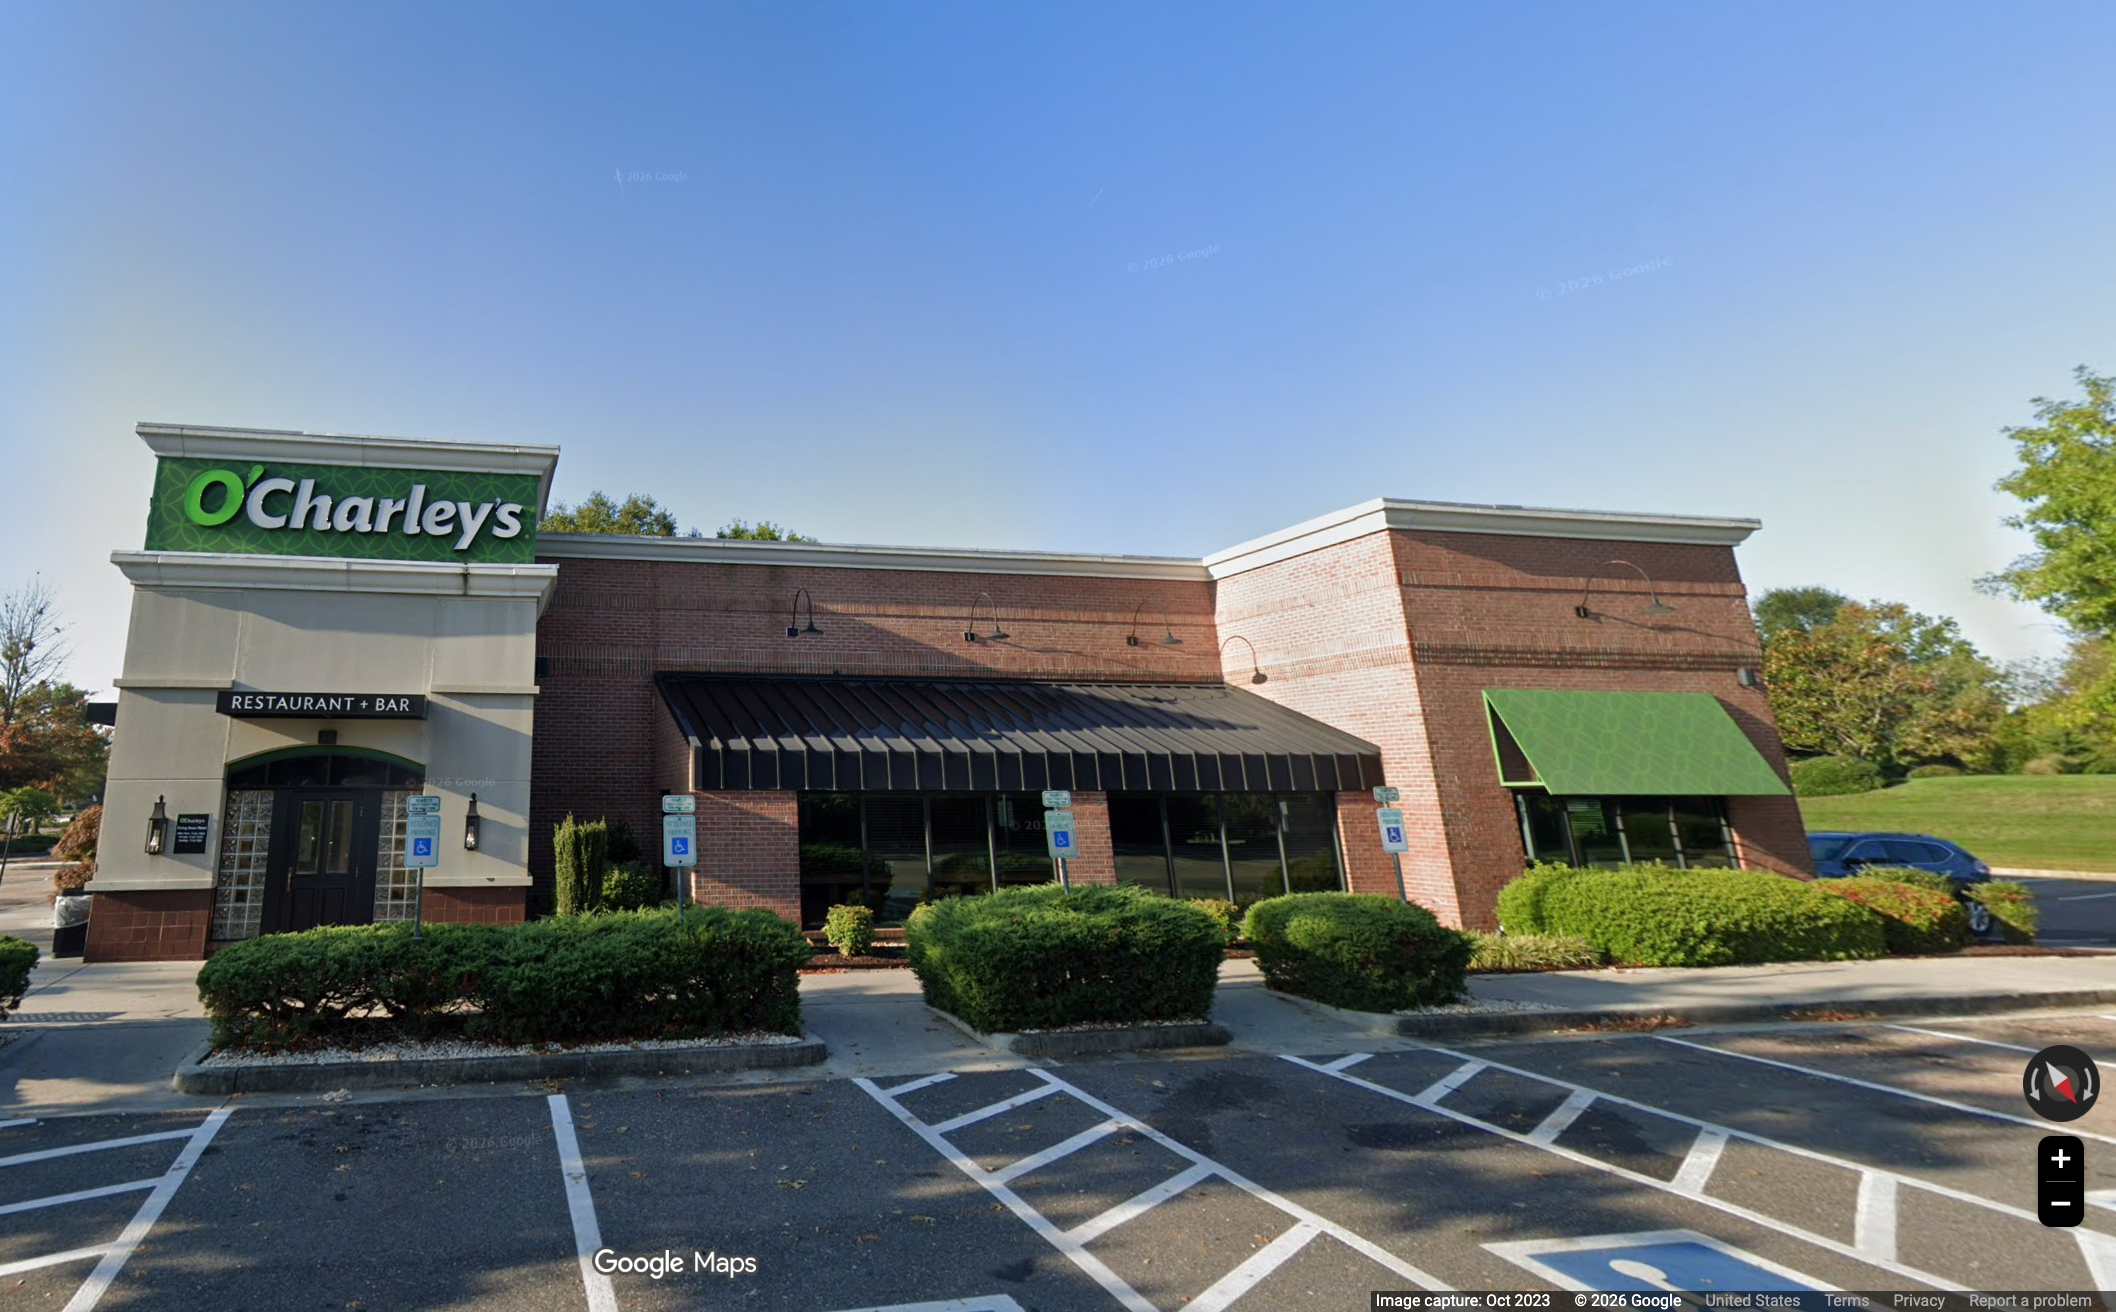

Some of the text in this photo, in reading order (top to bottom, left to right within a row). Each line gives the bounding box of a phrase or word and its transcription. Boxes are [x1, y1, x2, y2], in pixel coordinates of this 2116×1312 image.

[184, 465, 523, 550] O'Charley's
[231, 695, 355, 711] RESTAURANT
[375, 698, 410, 712] BAR
[667, 820, 693, 828] RESERVED
